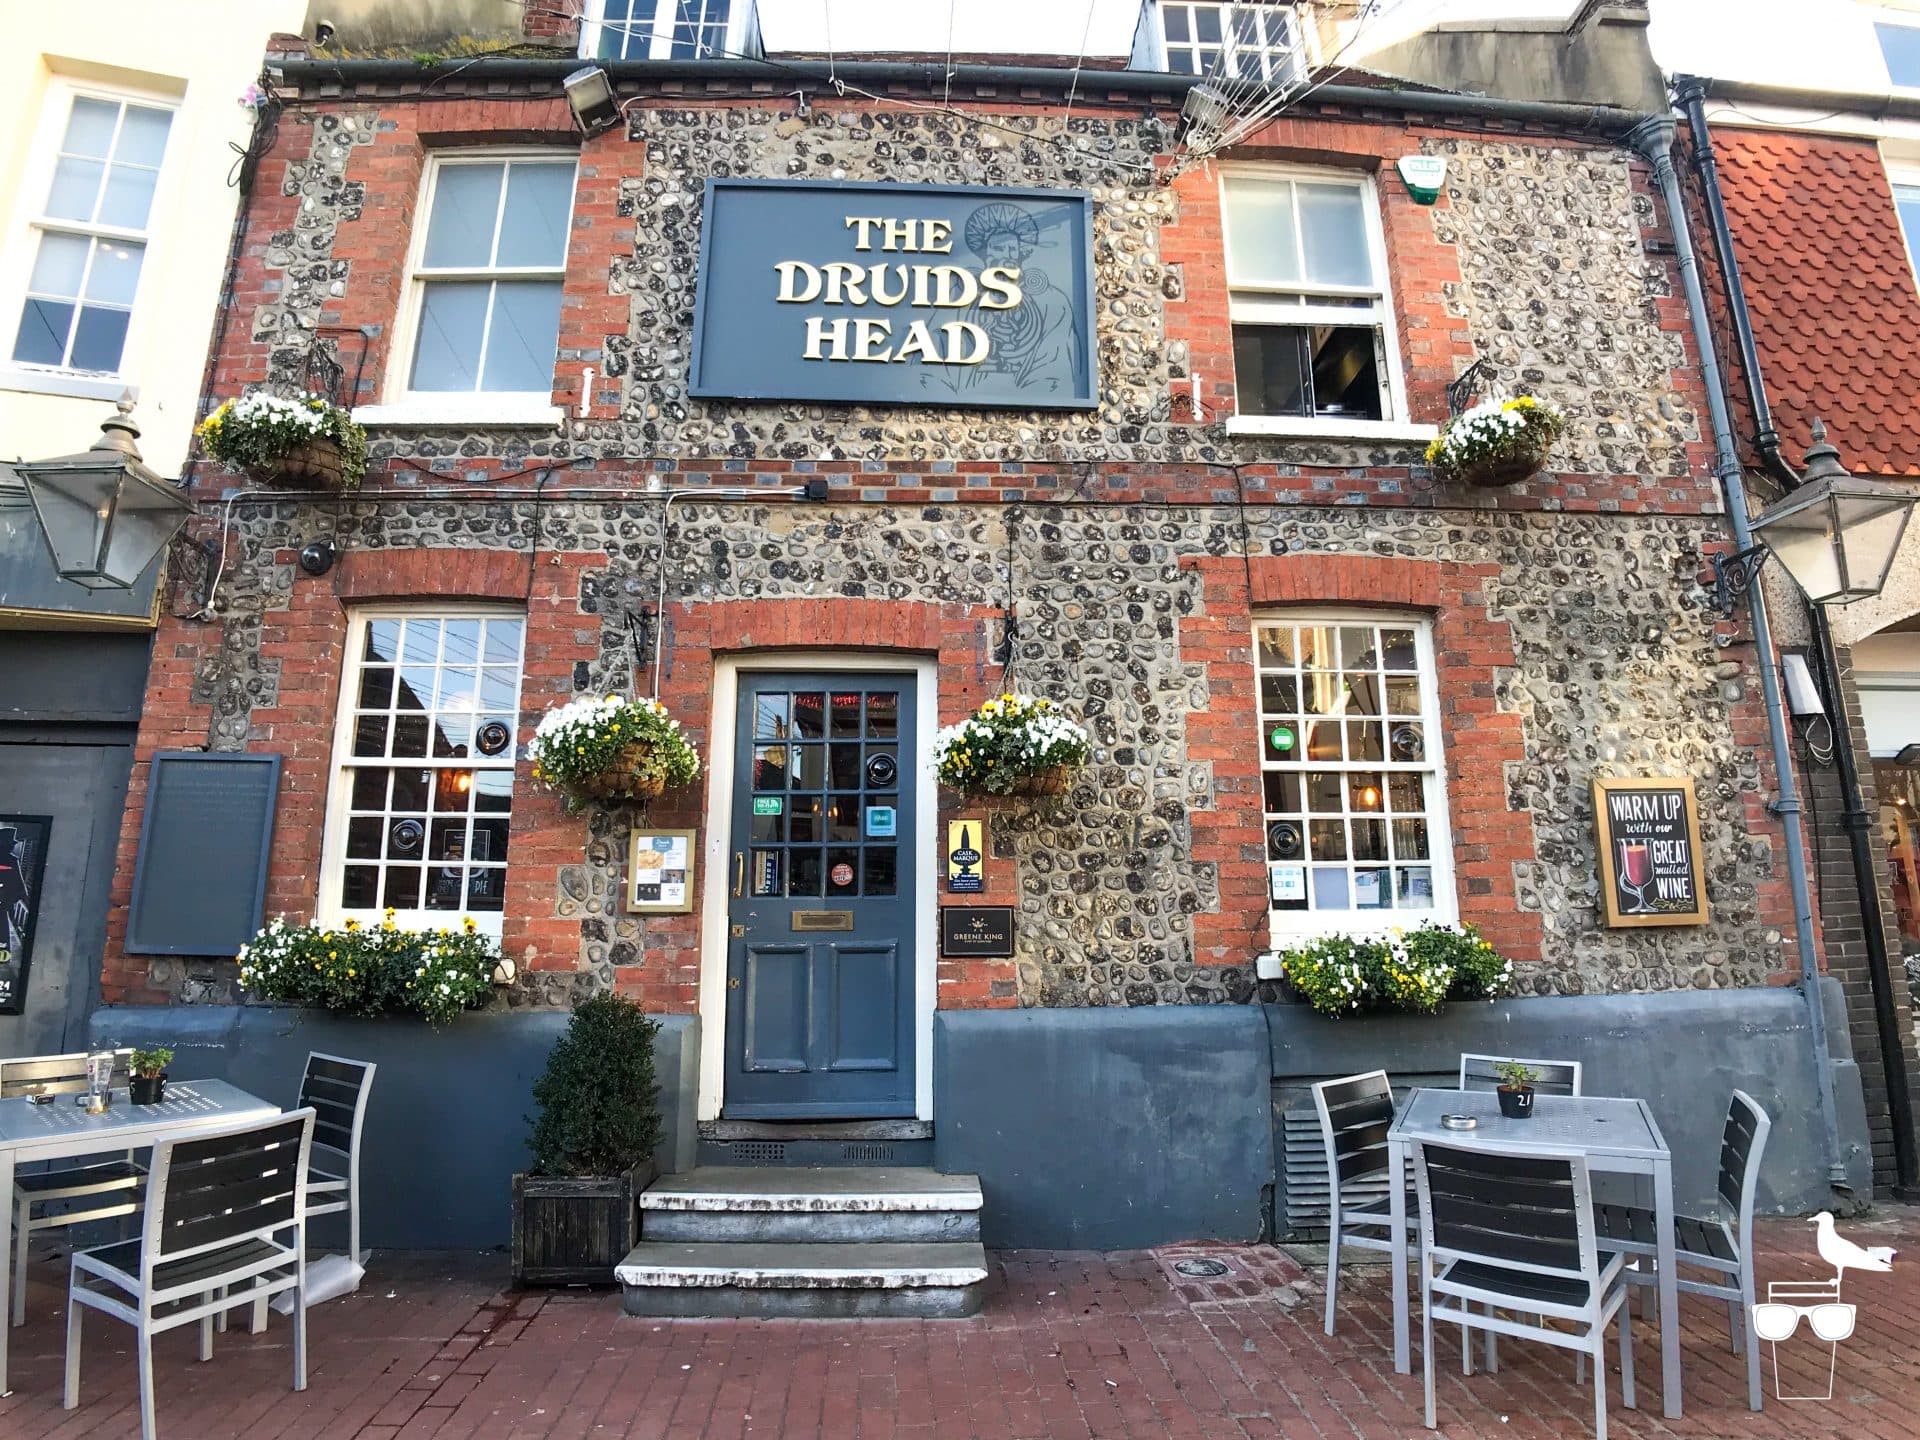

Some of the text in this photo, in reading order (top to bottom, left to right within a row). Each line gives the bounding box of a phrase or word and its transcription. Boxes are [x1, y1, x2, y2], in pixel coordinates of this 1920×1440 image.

[845, 215, 954, 254] THE
[774, 260, 1024, 310] DRUIDS
[802, 317, 991, 365] HEAD
[1610, 794, 1681, 821] WARM UP
[1625, 822, 1673, 834] with our
[1652, 840, 1687, 864] GREAT
[1654, 863, 1689, 875] mulled
[1656, 877, 1692, 899] WINE
[1517, 1094, 1531, 1106] 21
